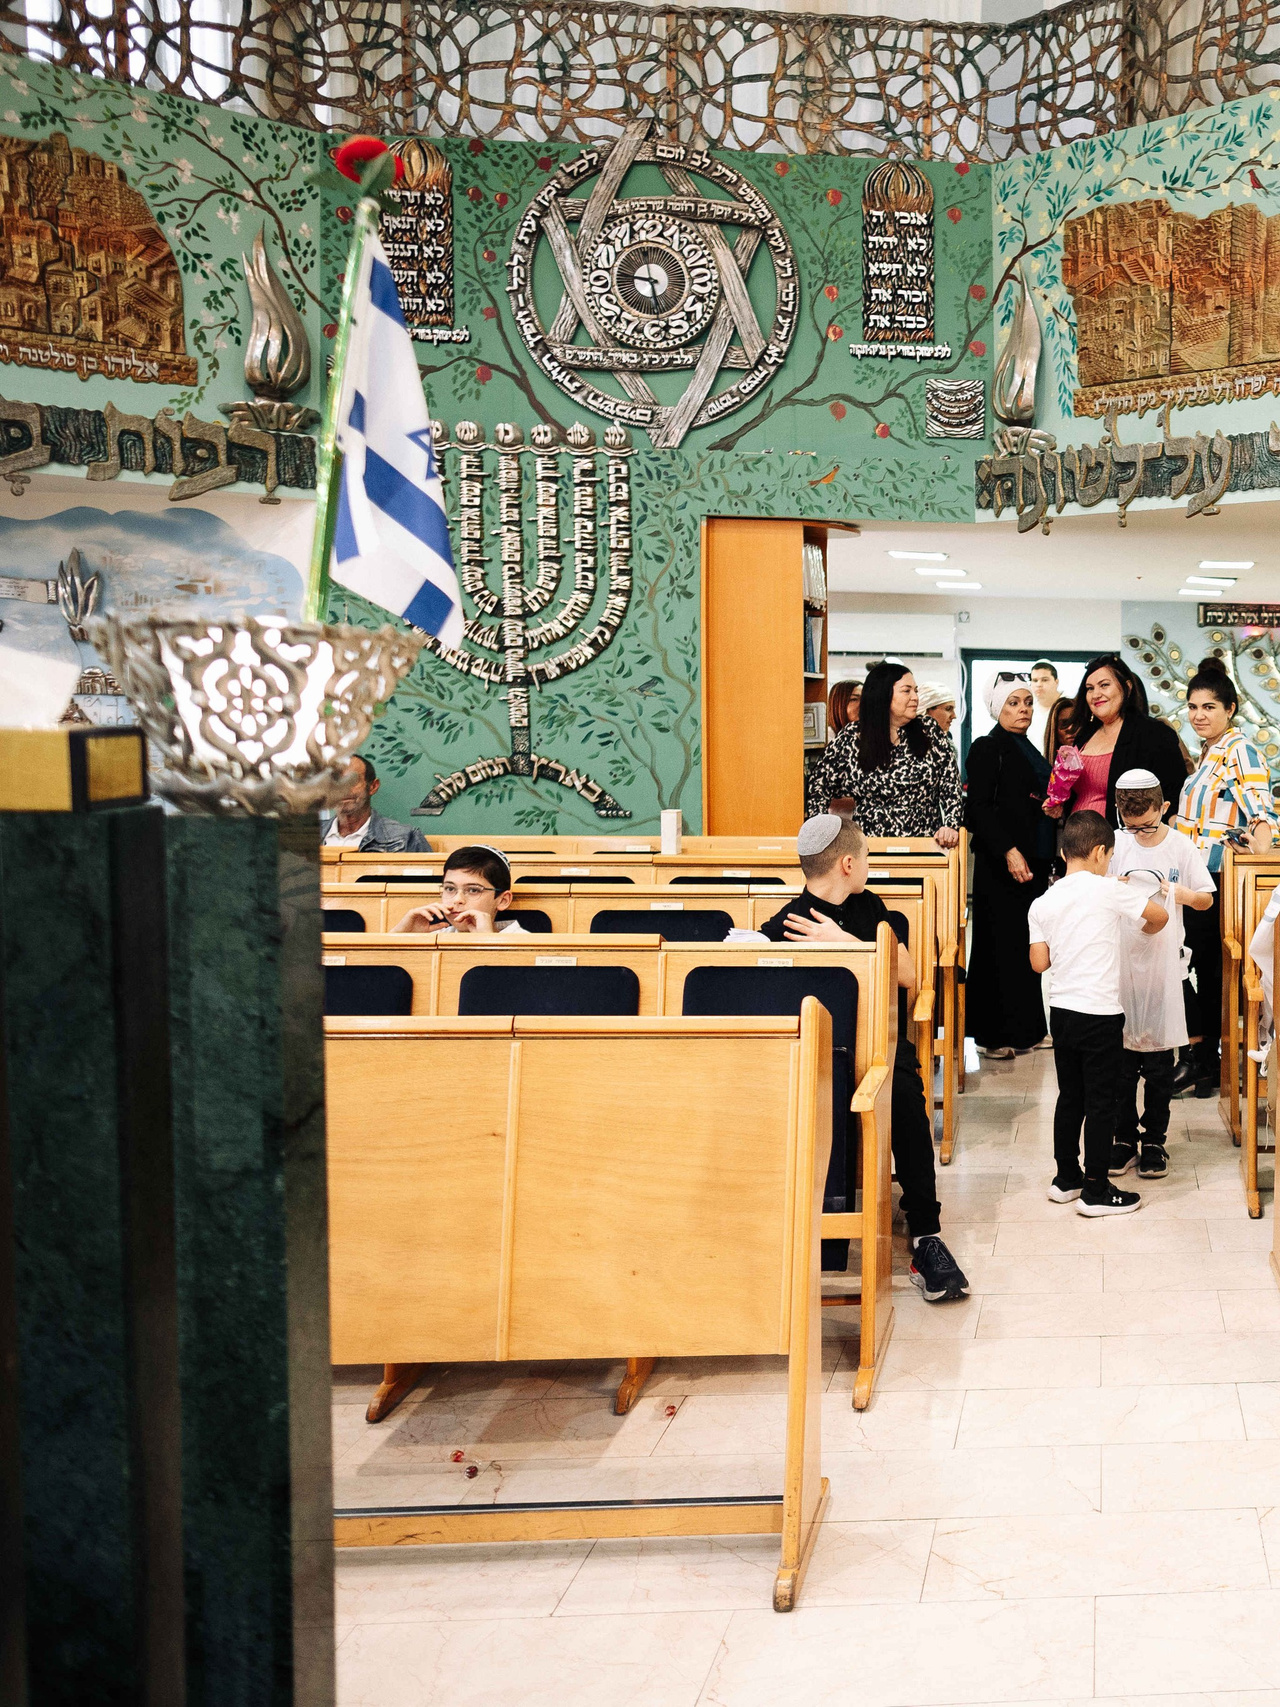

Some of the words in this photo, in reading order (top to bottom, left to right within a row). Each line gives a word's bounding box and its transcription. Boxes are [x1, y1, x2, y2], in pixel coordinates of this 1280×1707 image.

[655, 144, 686, 161] חכם
[690, 150, 711, 169] לב
[560, 149, 599, 177] לכל
[711, 164, 738, 183] ידע
[424, 185, 444, 205] לא
[536, 179, 562, 207] זמן
[737, 183, 772, 223] ומשפט
[383, 213, 417, 235] תנאף
[425, 211, 445, 231] לא
[516, 209, 541, 245] ועת
[895, 211, 928, 225] אנכי
[383, 243, 418, 257] תגנב
[423, 238, 445, 258] לא
[868, 235, 898, 249] יהיה
[907, 230, 927, 251] לא
[393, 270, 418, 283] תענ
[426, 265, 445, 284] לא
[505, 253, 526, 292] לכל
[868, 262, 902, 277] תשא
[907, 257, 927, 277] לא
[426, 290, 445, 311] לא
[780, 282, 795, 312] דבר
[871, 288, 892, 302] את
[897, 290, 927, 303] זכור
[868, 314, 890, 328] את
[895, 315, 927, 329] כבד
[19, 343, 77, 366] סולטנה
[83, 356, 98, 373] בן
[104, 349, 160, 378] אליהו
[764, 344, 785, 365] לא
[542, 353, 582, 392] תחת
[587, 392, 653, 422] השמים
[708, 393, 740, 416] שומר
[434, 771, 467, 801] סלה
[531, 753, 603, 803] בארץ
